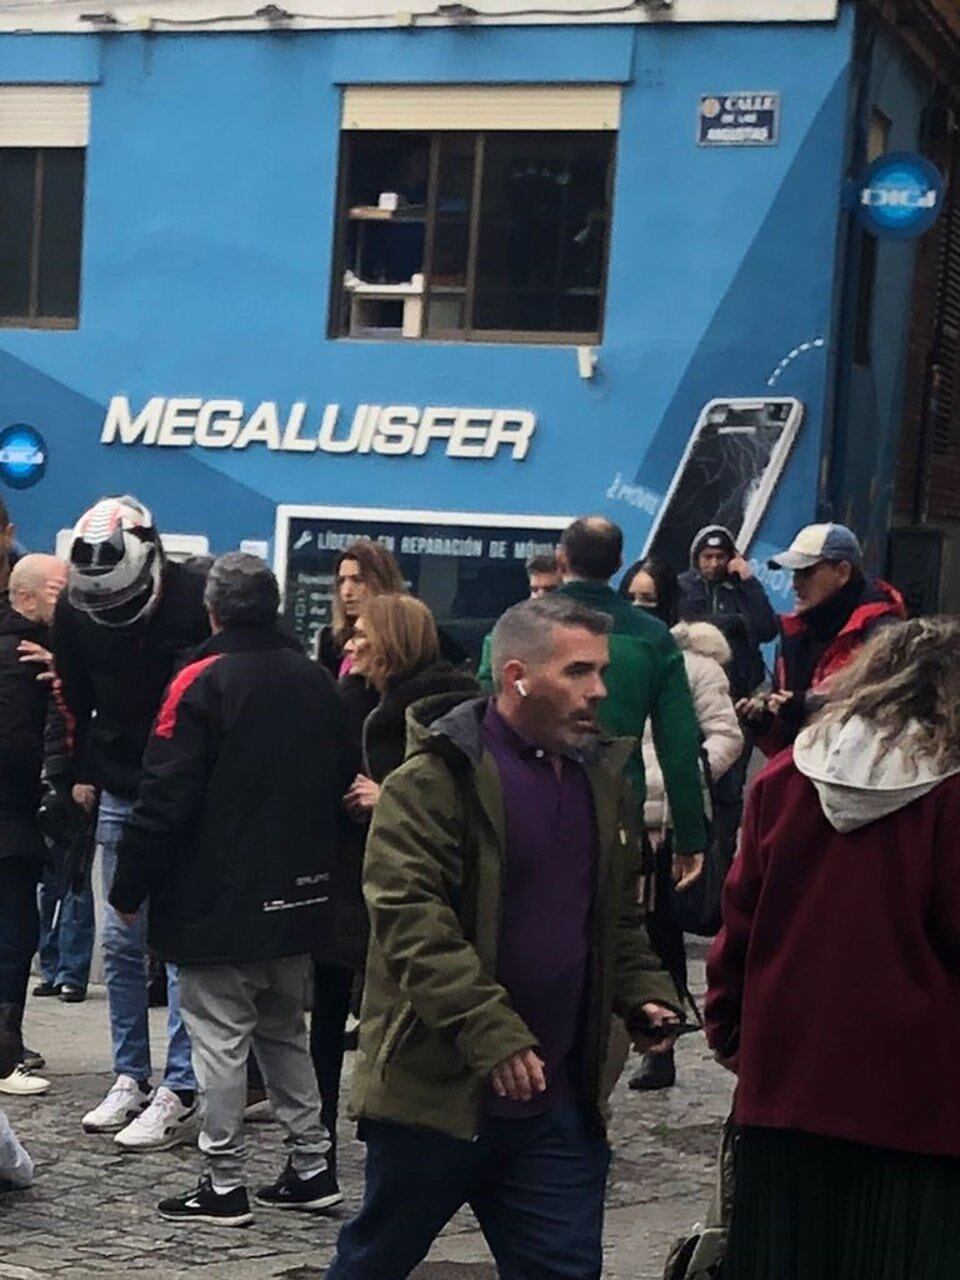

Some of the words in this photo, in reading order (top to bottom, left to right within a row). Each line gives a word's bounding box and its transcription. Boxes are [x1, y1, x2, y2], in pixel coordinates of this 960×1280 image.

[100, 395, 536, 461] MEGALUISFER
[400, 536, 483, 557] REPARACIÓN
[489, 541, 507, 558] DE
